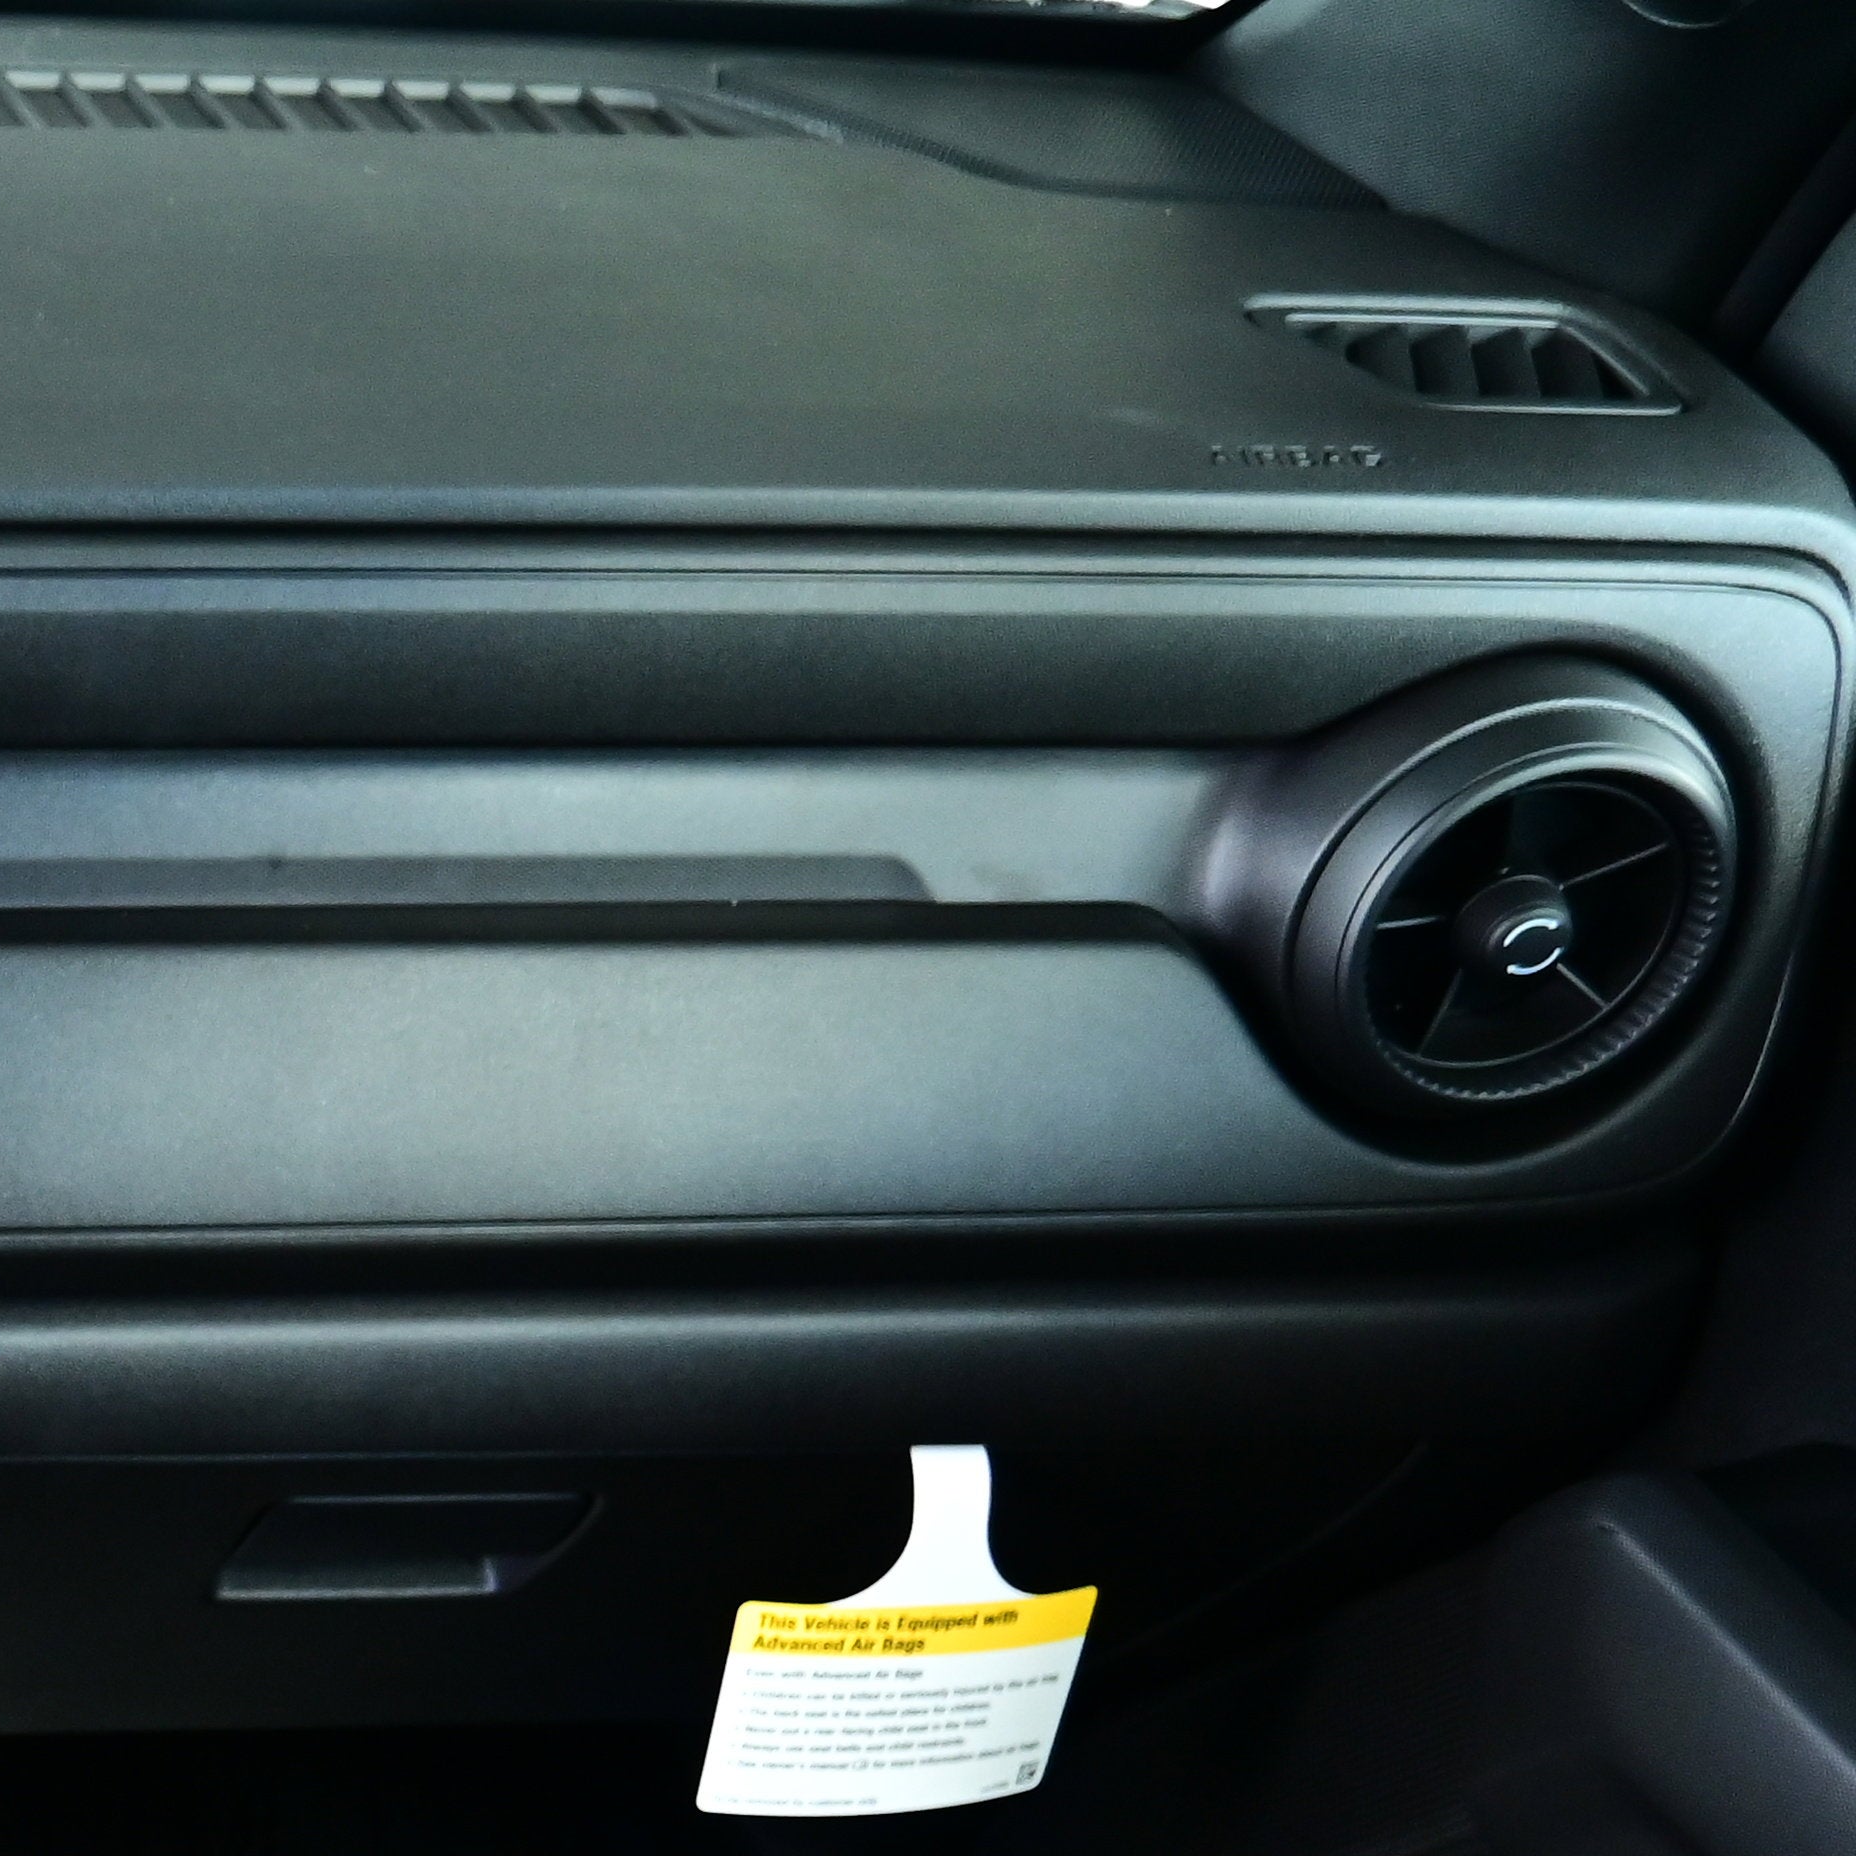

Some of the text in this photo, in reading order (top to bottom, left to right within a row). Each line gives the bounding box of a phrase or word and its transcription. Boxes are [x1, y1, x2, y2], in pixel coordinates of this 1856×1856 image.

[759, 1610, 1019, 1633] This Vehicle is Equipped with
[753, 1635, 925, 1654] Advanced Air Bags
